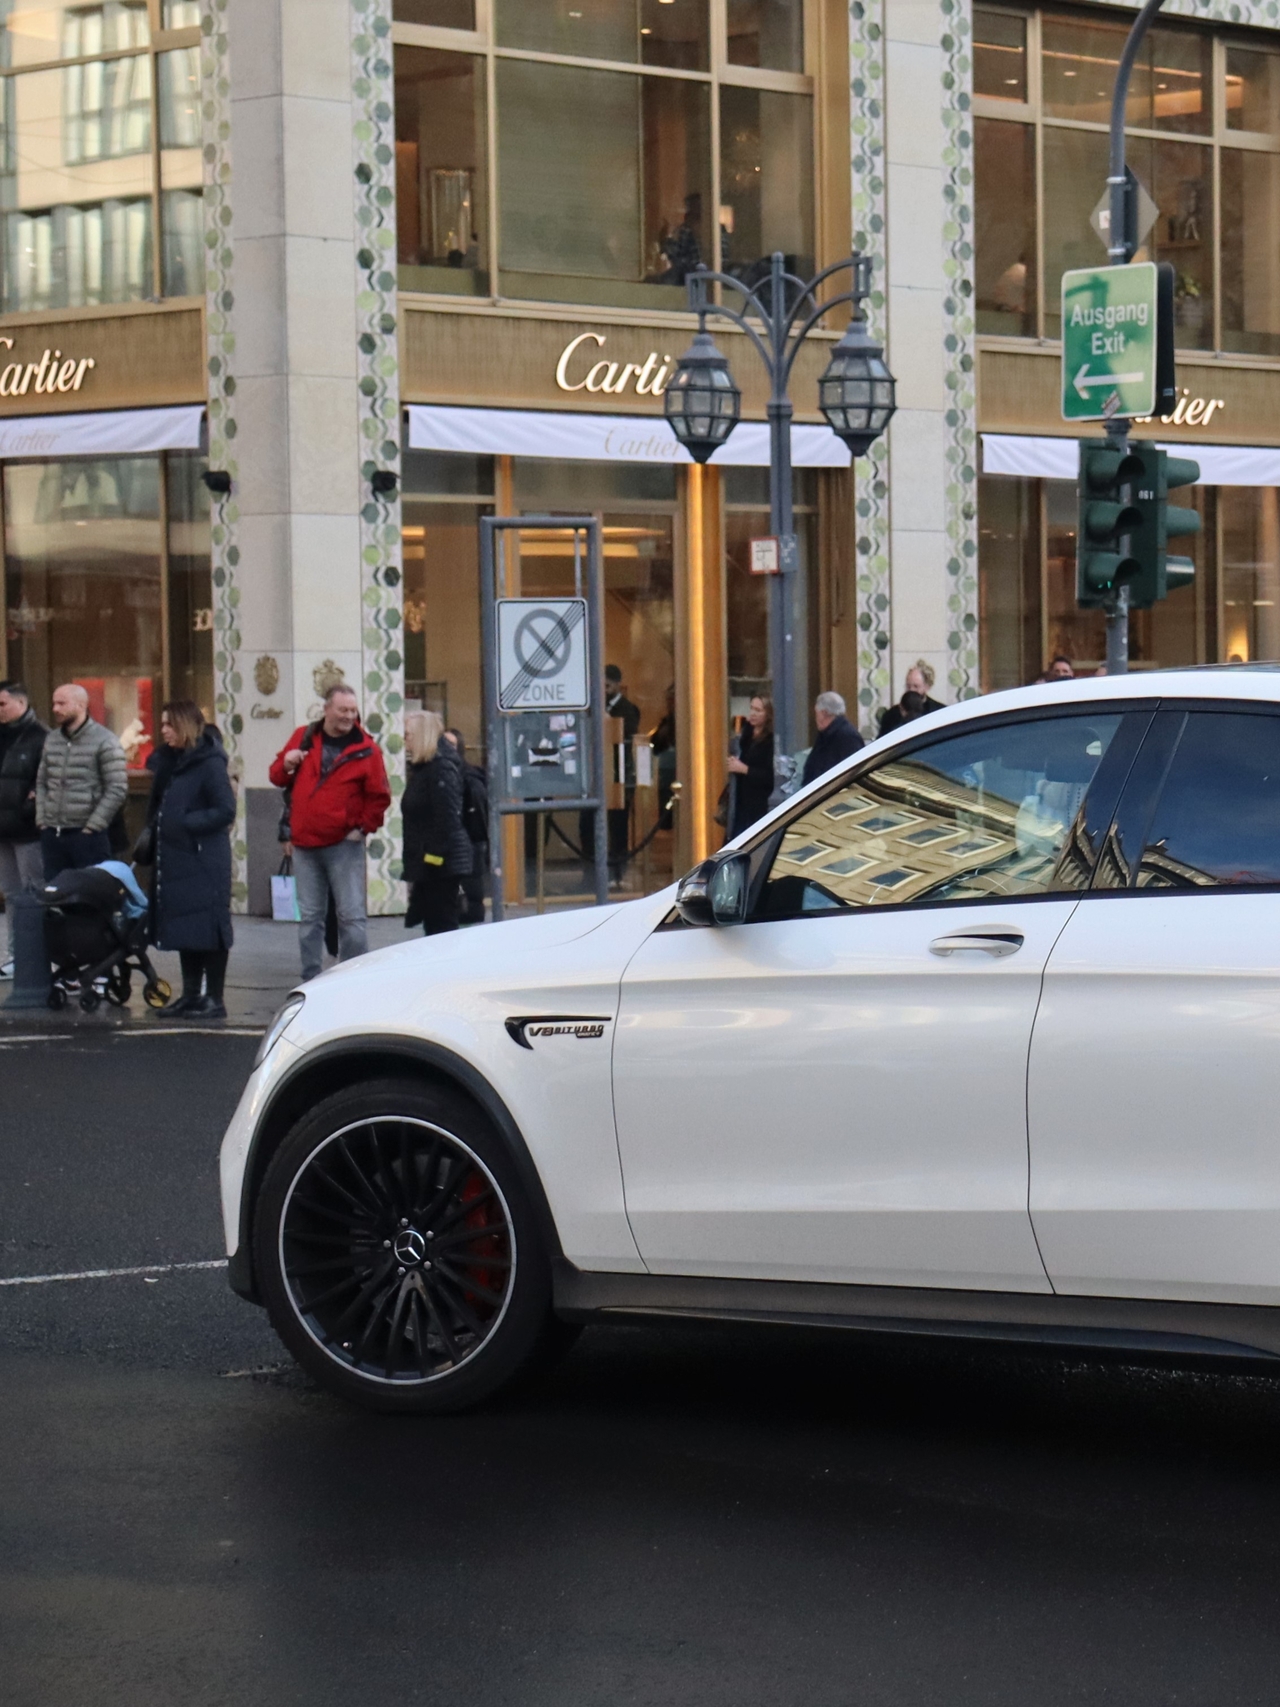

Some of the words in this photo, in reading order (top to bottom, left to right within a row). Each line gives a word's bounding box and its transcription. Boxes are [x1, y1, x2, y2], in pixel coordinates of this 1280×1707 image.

[1070, 303, 1148, 329] Ausgang
[1091, 331, 1125, 355] Exit
[556, 332, 672, 396] Carti
[523, 684, 566, 701] ZONE
